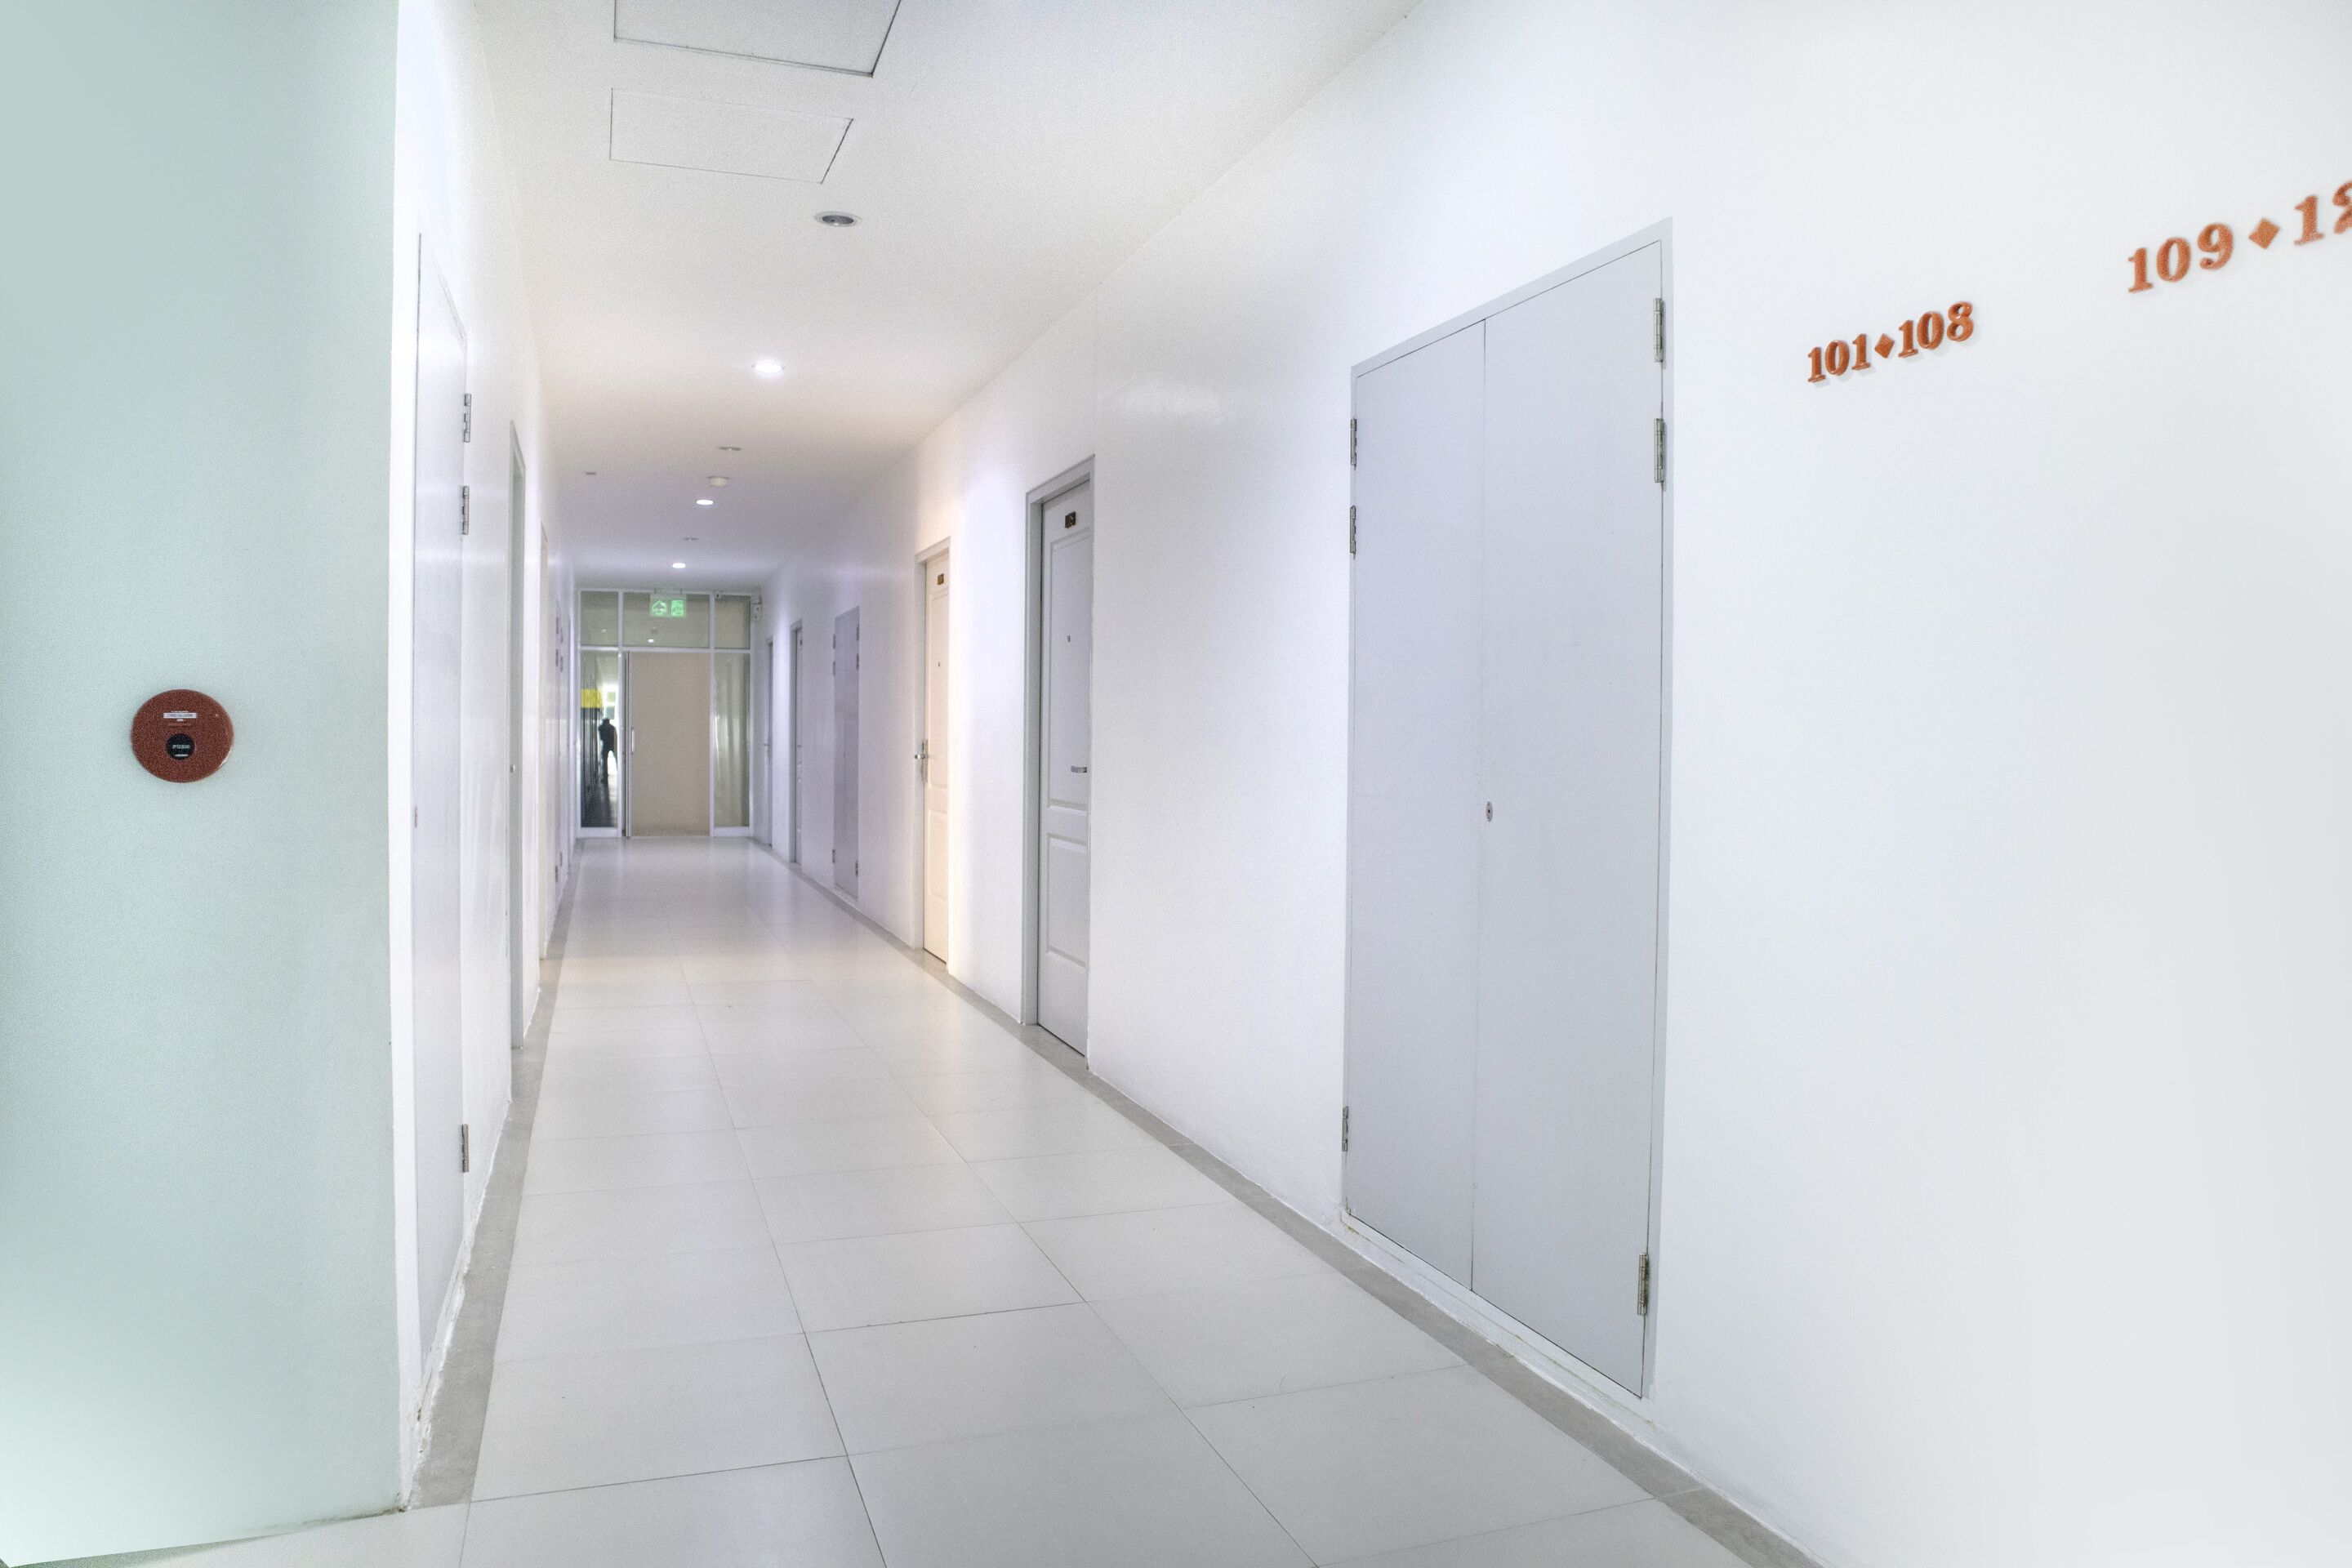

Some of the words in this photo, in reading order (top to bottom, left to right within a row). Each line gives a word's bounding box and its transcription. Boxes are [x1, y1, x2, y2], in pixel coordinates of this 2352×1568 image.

[2128, 223, 2234, 293] 109
[1807, 333, 1871, 382] 101
[1898, 301, 1974, 358] 108
